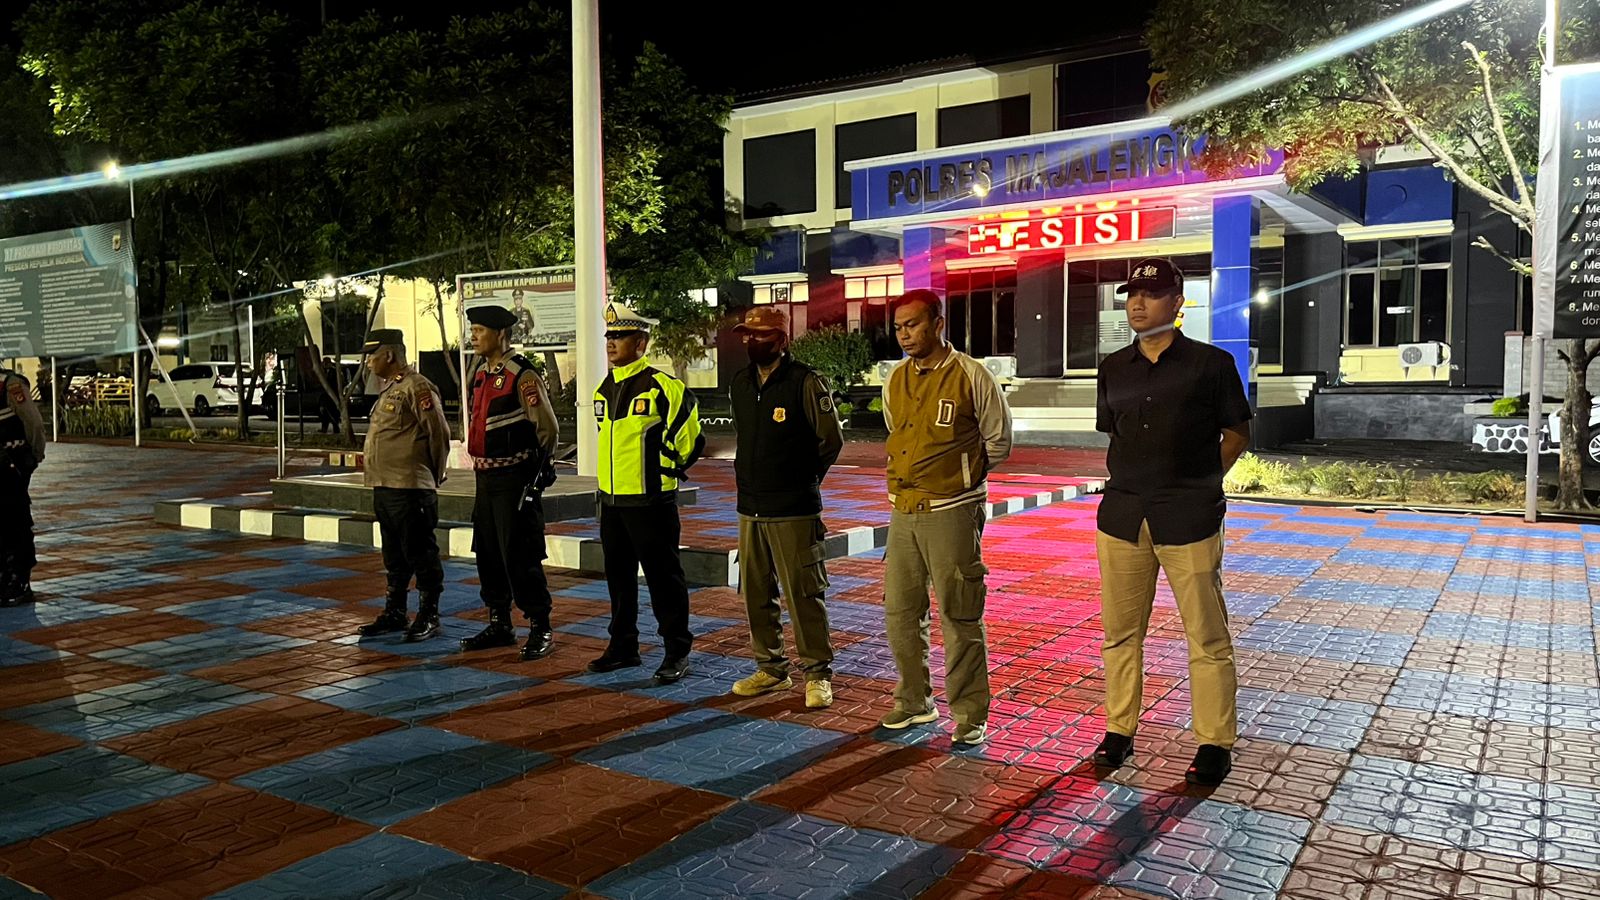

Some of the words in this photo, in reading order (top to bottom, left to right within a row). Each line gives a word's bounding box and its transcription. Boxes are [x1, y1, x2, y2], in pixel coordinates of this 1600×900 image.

[1574, 121, 1585, 131] 1.
[1573, 149, 1584, 159] 2.
[888, 158, 992, 208] POLRES
[1006, 132, 1202, 194] MAJALENGK
[1572, 177, 1583, 187] 3.
[1571, 233, 1582, 242] 5.
[1570, 274, 1580, 284] 7.
[463, 282, 475, 298] 8
[475, 279, 513, 290] KEBIJAKAN
[514, 276, 548, 287] KAPOLDA
[549, 274, 573, 284] JABAR
[1568, 302, 1579, 312] 8.
[935, 399, 956, 427] D
